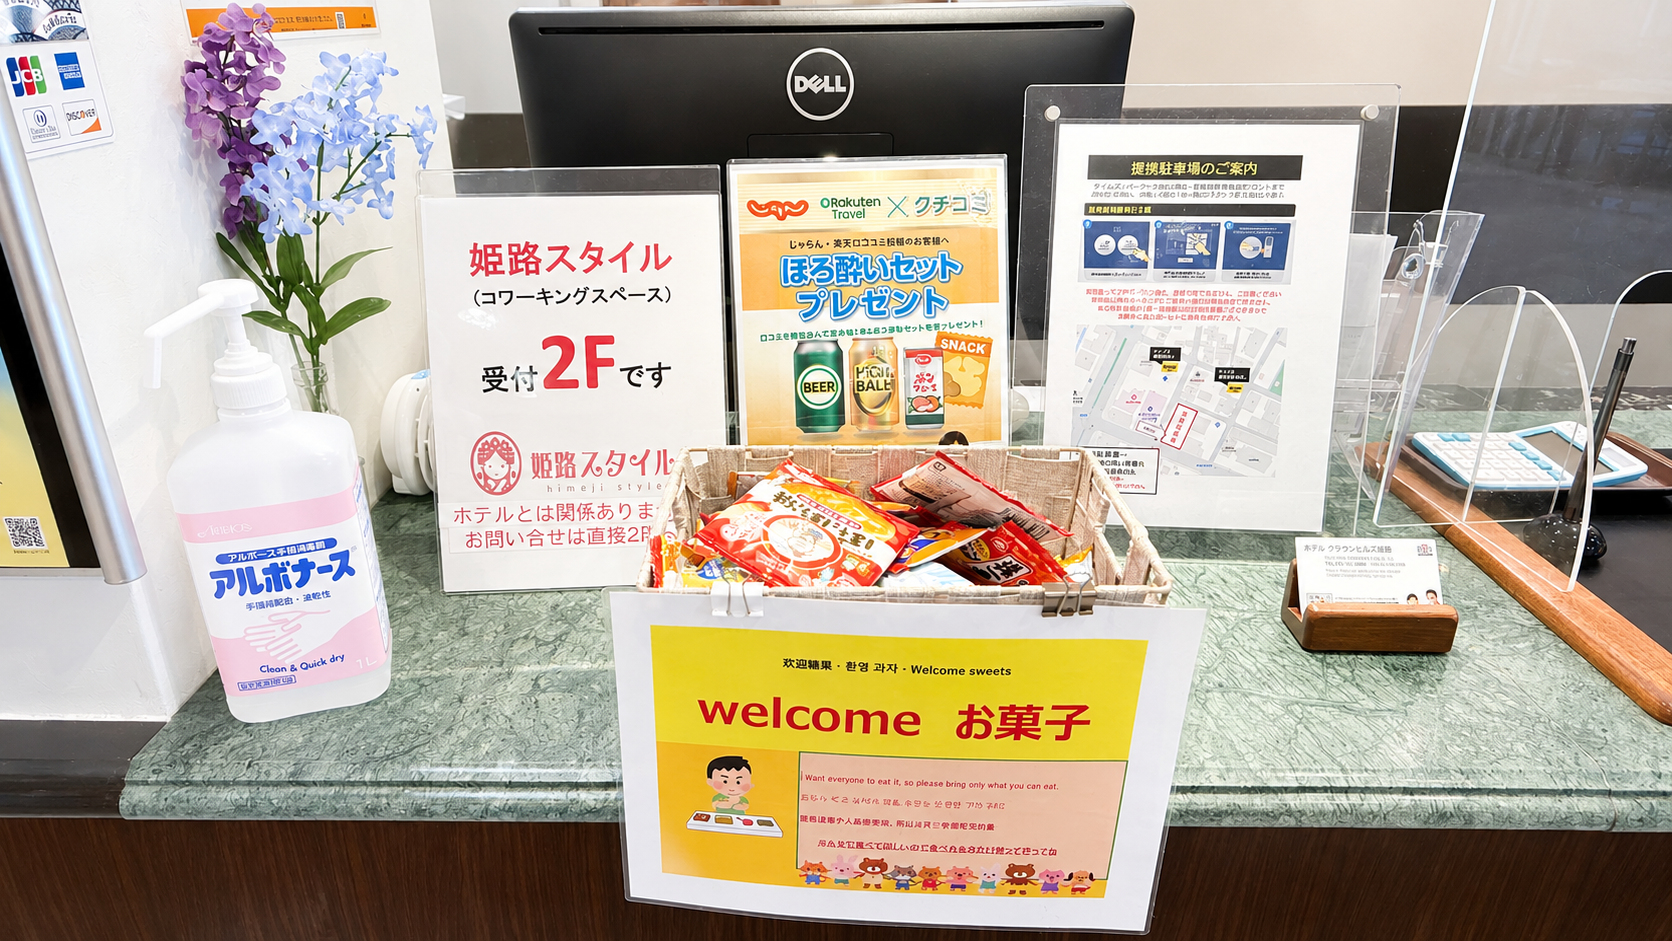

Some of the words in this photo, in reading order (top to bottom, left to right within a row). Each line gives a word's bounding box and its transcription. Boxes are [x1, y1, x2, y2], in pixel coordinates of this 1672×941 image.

[11, 68, 44, 85] JCB
[794, 74, 847, 94] DELL
[832, 209, 866, 220] Travel
[469, 240, 673, 277] 姫路スタイル
[781, 251, 963, 286] ほろ酔いセット
[473, 286, 671, 307] （コワーキングスペース）
[797, 286, 949, 321] プレゼント
[940, 338, 986, 355] SNACK
[803, 380, 836, 394] BEER
[530, 448, 674, 480] 姫路スタイル
[547, 483, 604, 493] himeji
[618, 482, 662, 492] style
[453, 501, 660, 524] ホテルとは関係ありま
[209, 549, 356, 599] アルボナース
[259, 664, 287, 674] Clean
[290, 664, 298, 673] &
[300, 657, 328, 671] Quick
[329, 654, 345, 664] dry
[845, 661, 869, 673] 환영
[873, 662, 898, 674] 과자
[911, 664, 966, 676] Welcome
[969, 666, 1012, 676] sweets
[697, 696, 921, 737] welcome
[955, 703, 1092, 742] お菓子
[804, 774, 825, 782] Want
[827, 776, 864, 785] everyone
[866, 777, 875, 785] to
[878, 778, 890, 786] eat
[893, 779, 902, 787] it,
[916, 780, 944, 788] please
[946, 780, 966, 790] bring
[968, 782, 986, 790] only
[1009, 783, 1024, 791] you
